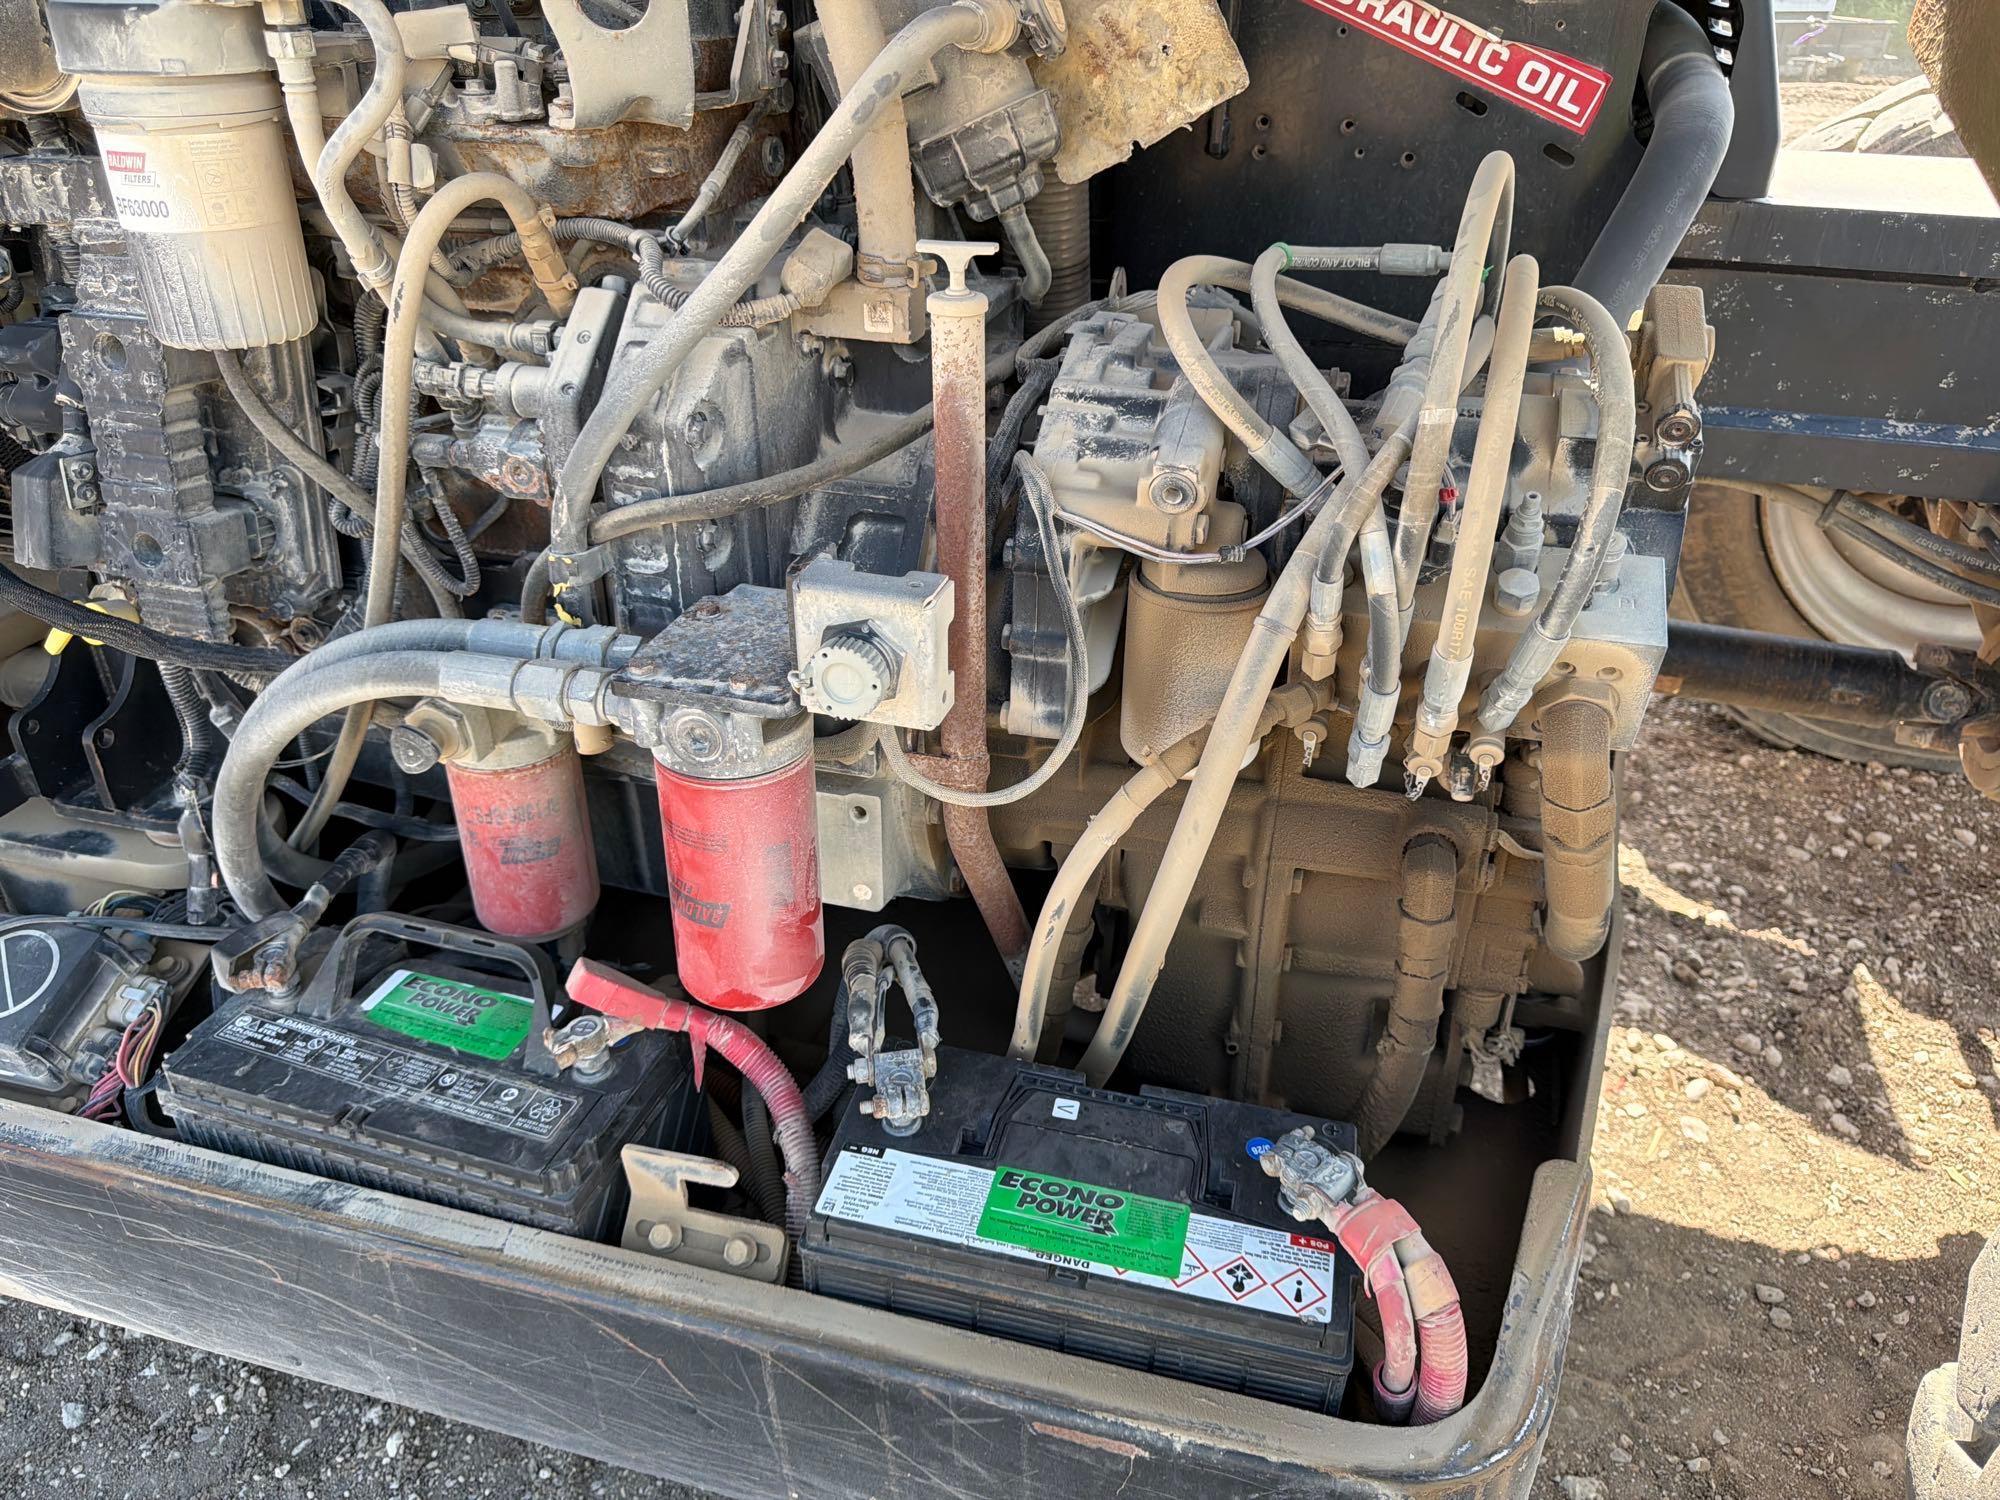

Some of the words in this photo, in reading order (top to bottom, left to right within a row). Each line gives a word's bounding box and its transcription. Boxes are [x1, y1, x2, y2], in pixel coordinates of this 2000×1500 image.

[1340, 0, 1510, 76] RAULIC
[1515, 60, 1582, 115] OIL
[108, 153, 143, 169] BALDWIN
[123, 173, 152, 185] FILTERS
[116, 196, 169, 218] BF63000
[1340, 256, 1371, 268] PILOT
[1458, 567, 1477, 599] SAE
[402, 976, 498, 1008] ECONO
[405, 992, 482, 1022] POWER
[861, 1146, 880, 1156] NEG
[999, 1171, 1125, 1209] ECONO
[1017, 1193, 1114, 1226] POWER
[1310, 1239, 1329, 1250] POS
[1034, 1251, 1090, 1269] DANGER
